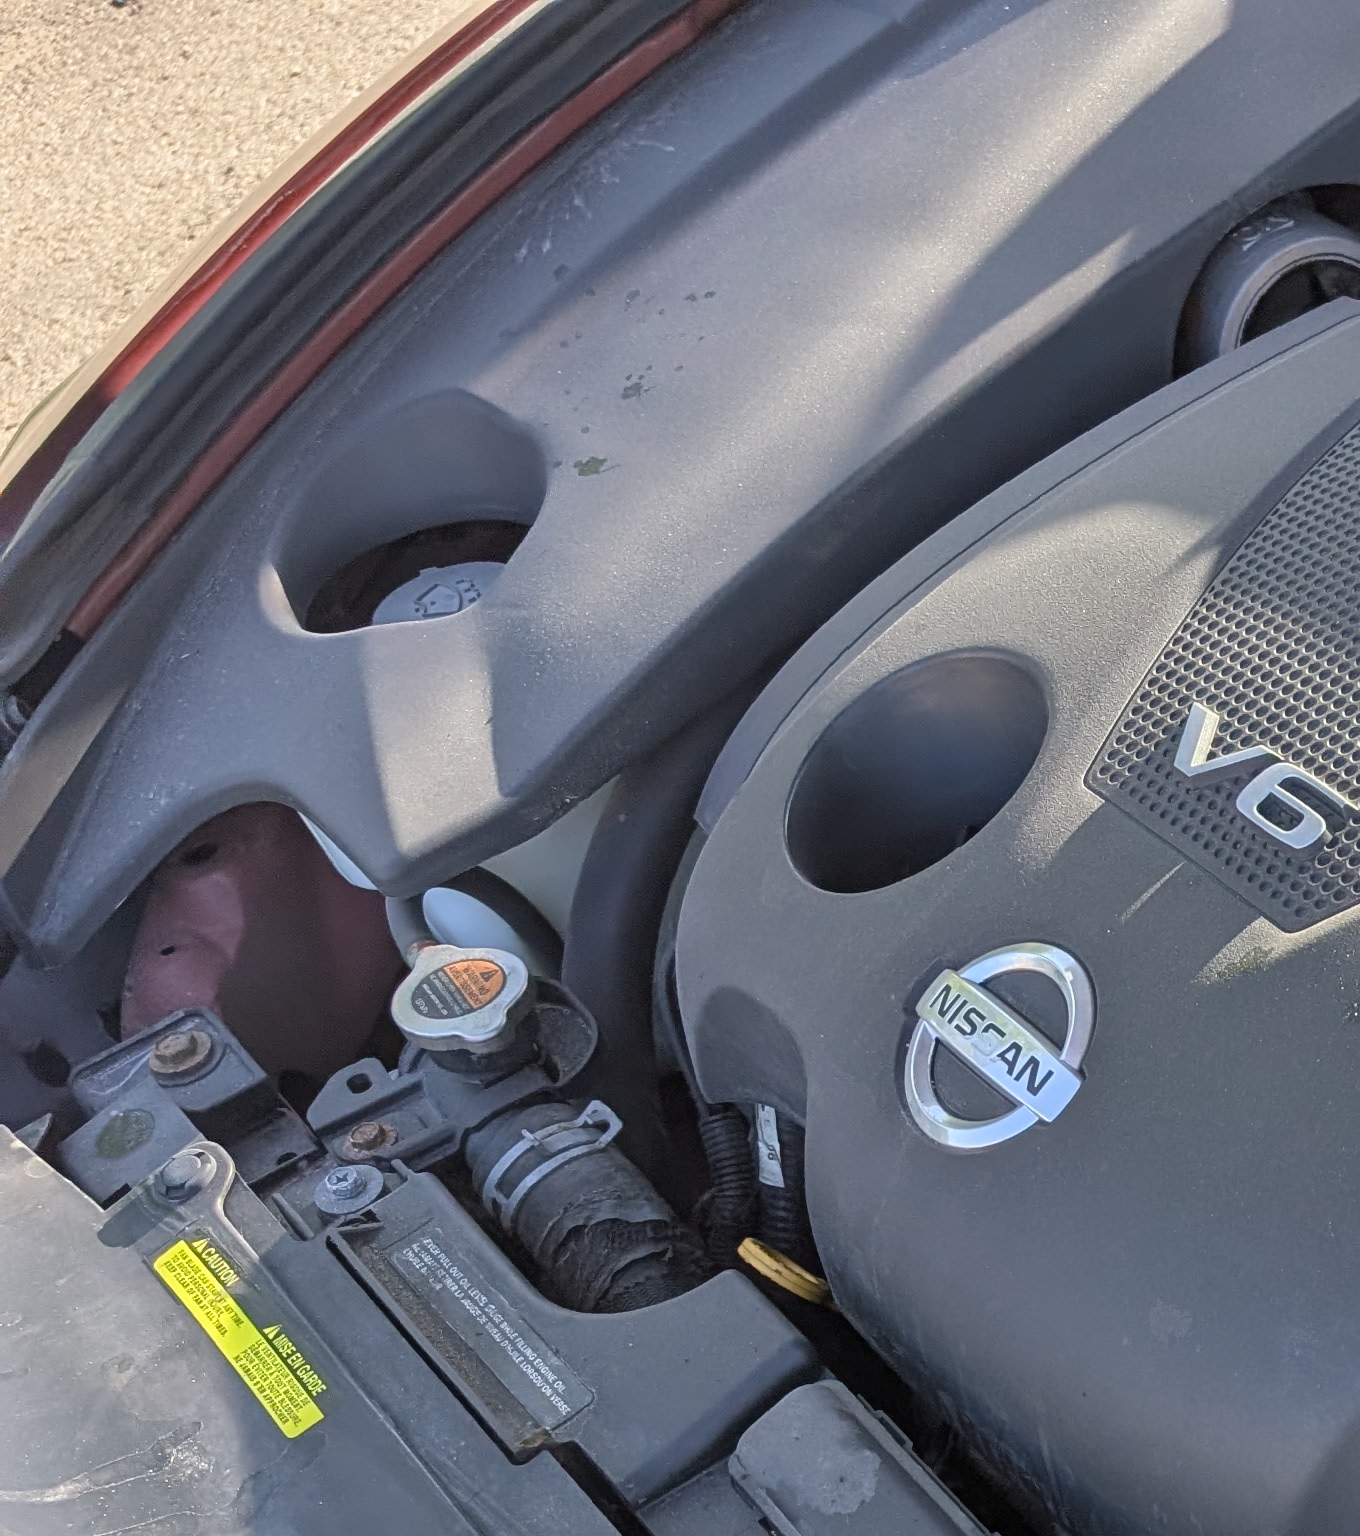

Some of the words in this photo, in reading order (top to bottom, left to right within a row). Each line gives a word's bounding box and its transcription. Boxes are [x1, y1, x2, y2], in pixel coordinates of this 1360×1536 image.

[1173, 702, 1357, 851] V6
[928, 983, 1055, 1098] NISSAN
[200, 1244, 240, 1289] CAUTION
[436, 1251, 453, 1269] PULL
[448, 1264, 464, 1281] OUT
[512, 1335, 537, 1361] FILLING
[531, 1356, 558, 1384] ENGINE
[271, 1332, 297, 1359] MISE
[285, 1350, 306, 1371] EN
[295, 1362, 327, 1398] GARDE
[548, 1392, 571, 1416] VERSE
